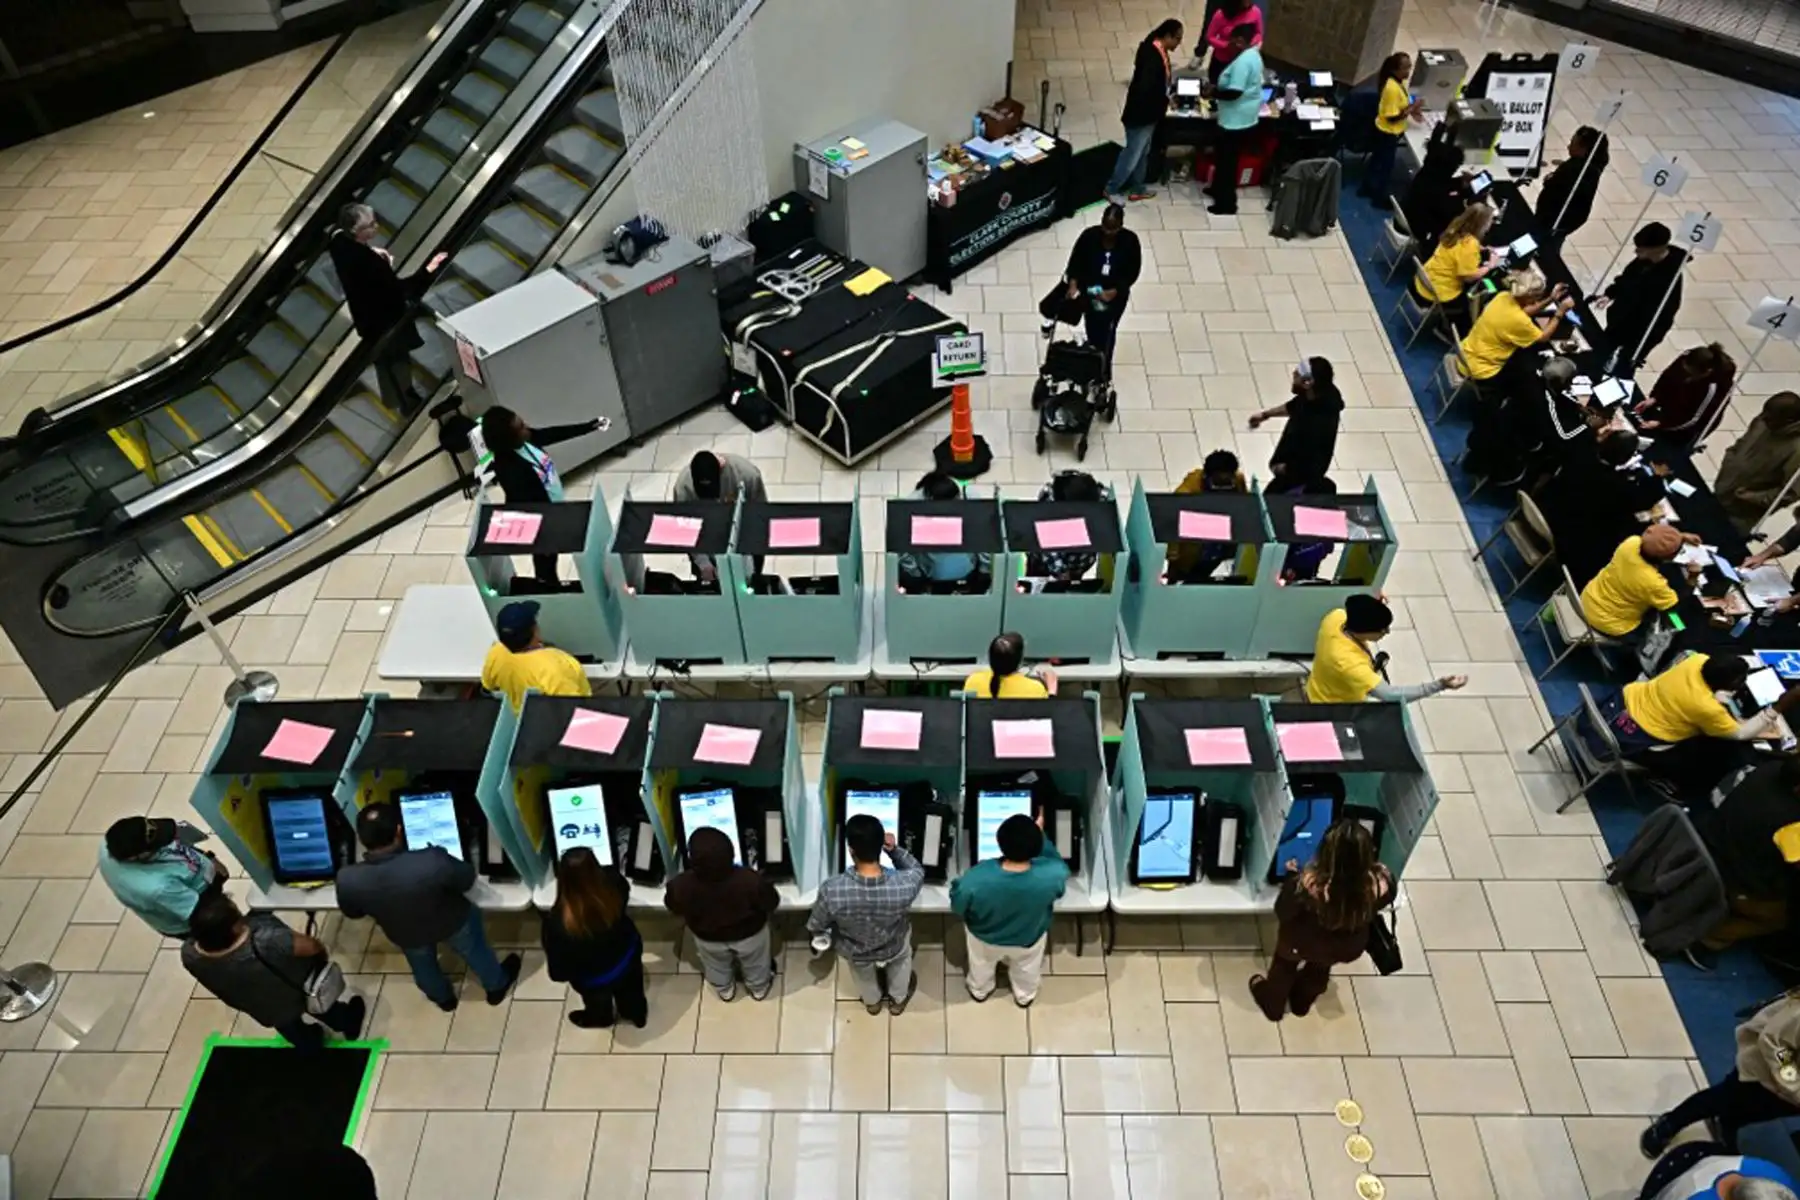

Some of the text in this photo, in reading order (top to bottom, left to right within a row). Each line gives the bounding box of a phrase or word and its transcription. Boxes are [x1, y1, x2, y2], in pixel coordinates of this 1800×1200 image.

[1571, 52, 1586, 69] 8
[1510, 101, 1543, 114] BALLOT
[1609, 101, 1623, 118] 7
[1515, 120, 1533, 133] BOX
[1654, 169, 1669, 187] 6
[1690, 223, 1707, 243] 5
[1766, 311, 1787, 329] 4
[946, 340, 972, 350] CARD
[943, 351, 977, 361] RETURN
